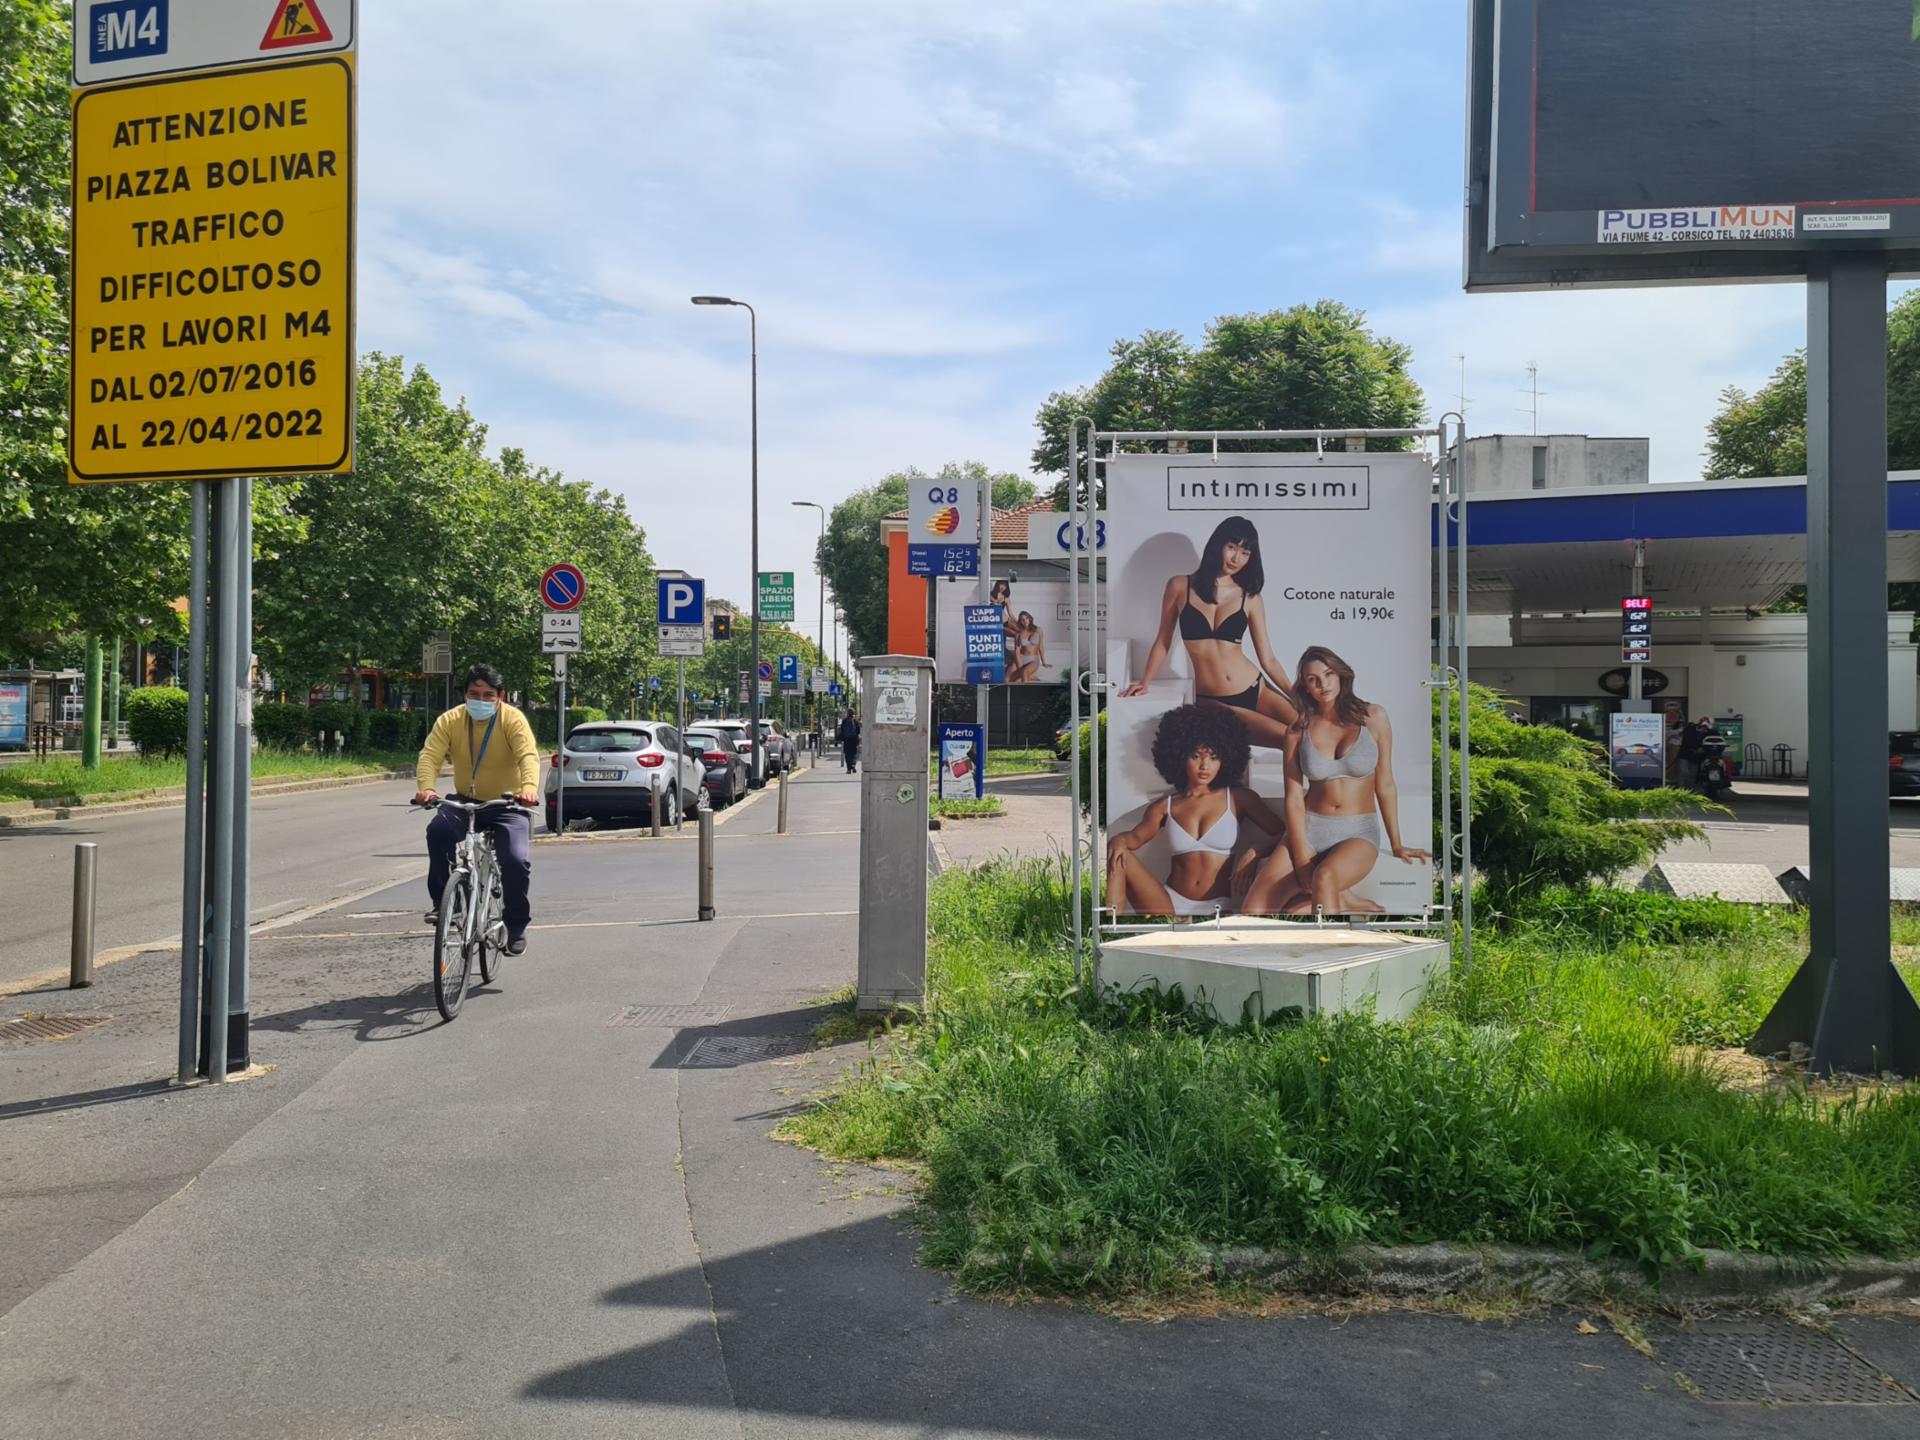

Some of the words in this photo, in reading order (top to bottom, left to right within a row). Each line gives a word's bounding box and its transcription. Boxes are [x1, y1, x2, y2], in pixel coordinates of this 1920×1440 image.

[98, 14, 107, 53] LINEA
[107, 6, 160, 52] M4
[113, 99, 308, 148] ATTENZIONE
[87, 165, 191, 202] PIAZZA
[207, 150, 337, 189] BOLIVAR
[132, 208, 285, 248] TRAFFICO
[1603, 232, 1618, 242] VIA
[1621, 232, 1650, 242] FIUME
[1652, 231, 1664, 241] 42
[1671, 230, 1714, 241] CORSICO
[1717, 230, 1737, 240] TEL.
[1739, 229, 1750, 239] 02
[1753, 229, 1793, 239] 4403636
[101, 258, 321, 303] DIFFICOLTOSO
[90, 324, 147, 354] PER
[162, 313, 267, 348] LAVORI
[285, 310, 331, 339] M4
[90, 373, 145, 404] DAL
[148, 359, 317, 398] 02/07/2016
[90, 424, 127, 451] AL
[141, 408, 323, 447] 22/04/2022
[928, 486, 959, 504] Q8
[1180, 479, 1357, 498] intimissimi
[667, 583, 694, 620] P
[1283, 587, 1336, 601] Cotone
[1339, 586, 1395, 601] naturale
[972, 608, 995, 616] L'APP
[1625, 598, 1649, 608] SELF
[550, 619, 572, 627] 0-24
[1330, 606, 1346, 621] da
[1351, 607, 1395, 622] 19,90€
[968, 634, 1002, 643] PUNTI
[969, 643, 1002, 652] DOPPI
[783, 657, 793, 670] P
[945, 727, 974, 739] Aperto
